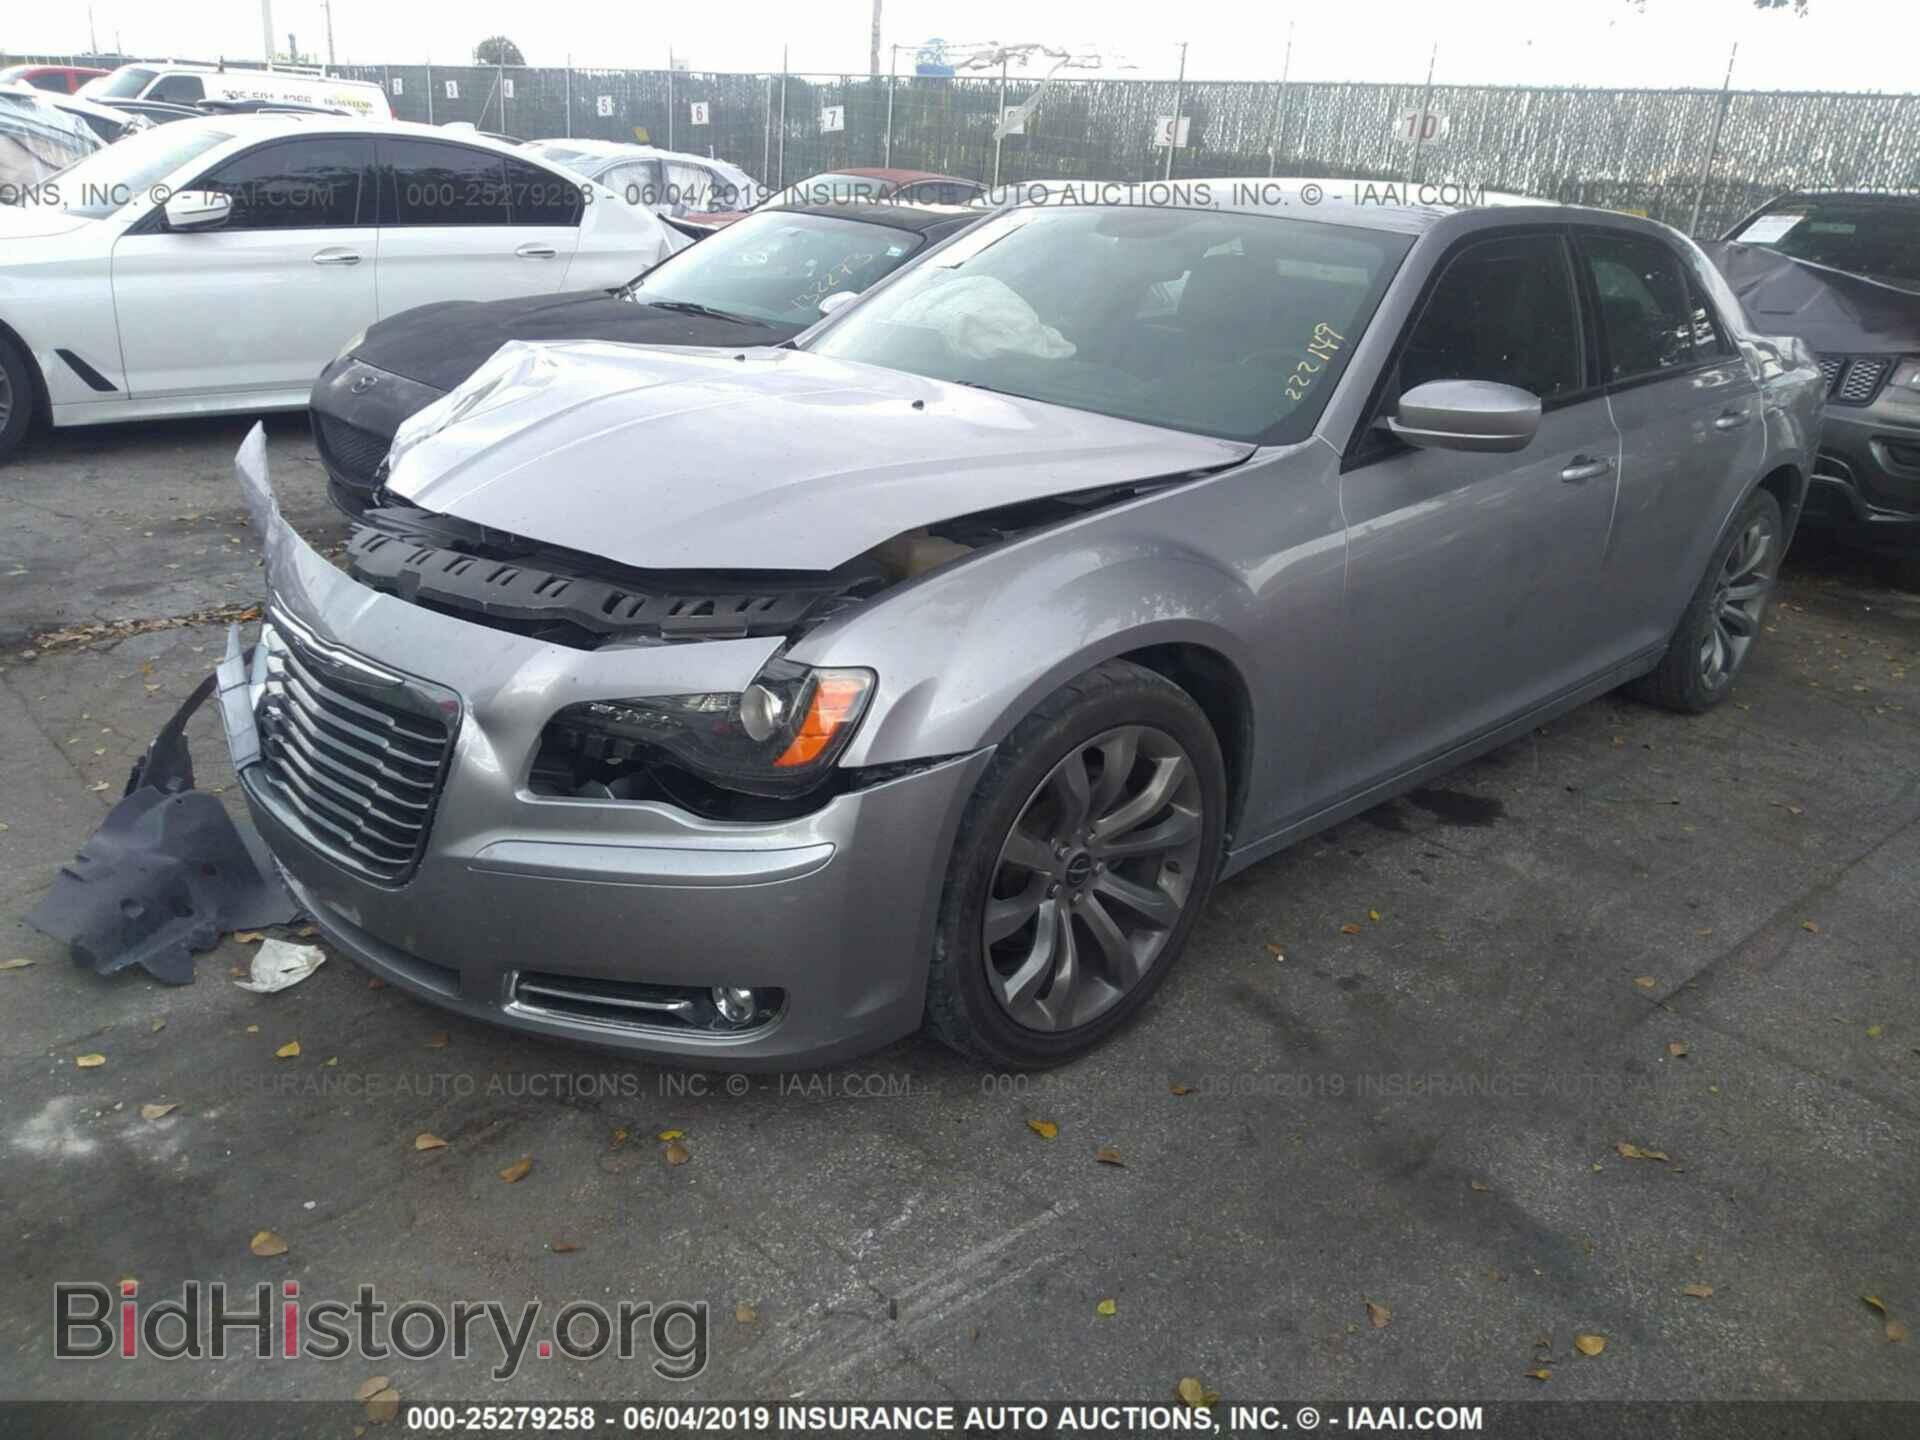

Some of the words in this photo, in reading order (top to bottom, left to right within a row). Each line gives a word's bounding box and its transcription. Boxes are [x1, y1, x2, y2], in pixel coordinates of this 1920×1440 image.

[601, 99, 609, 113] 5
[695, 105, 703, 121] 6
[829, 109, 838, 127] 7
[1406, 113, 1438, 140] 10
